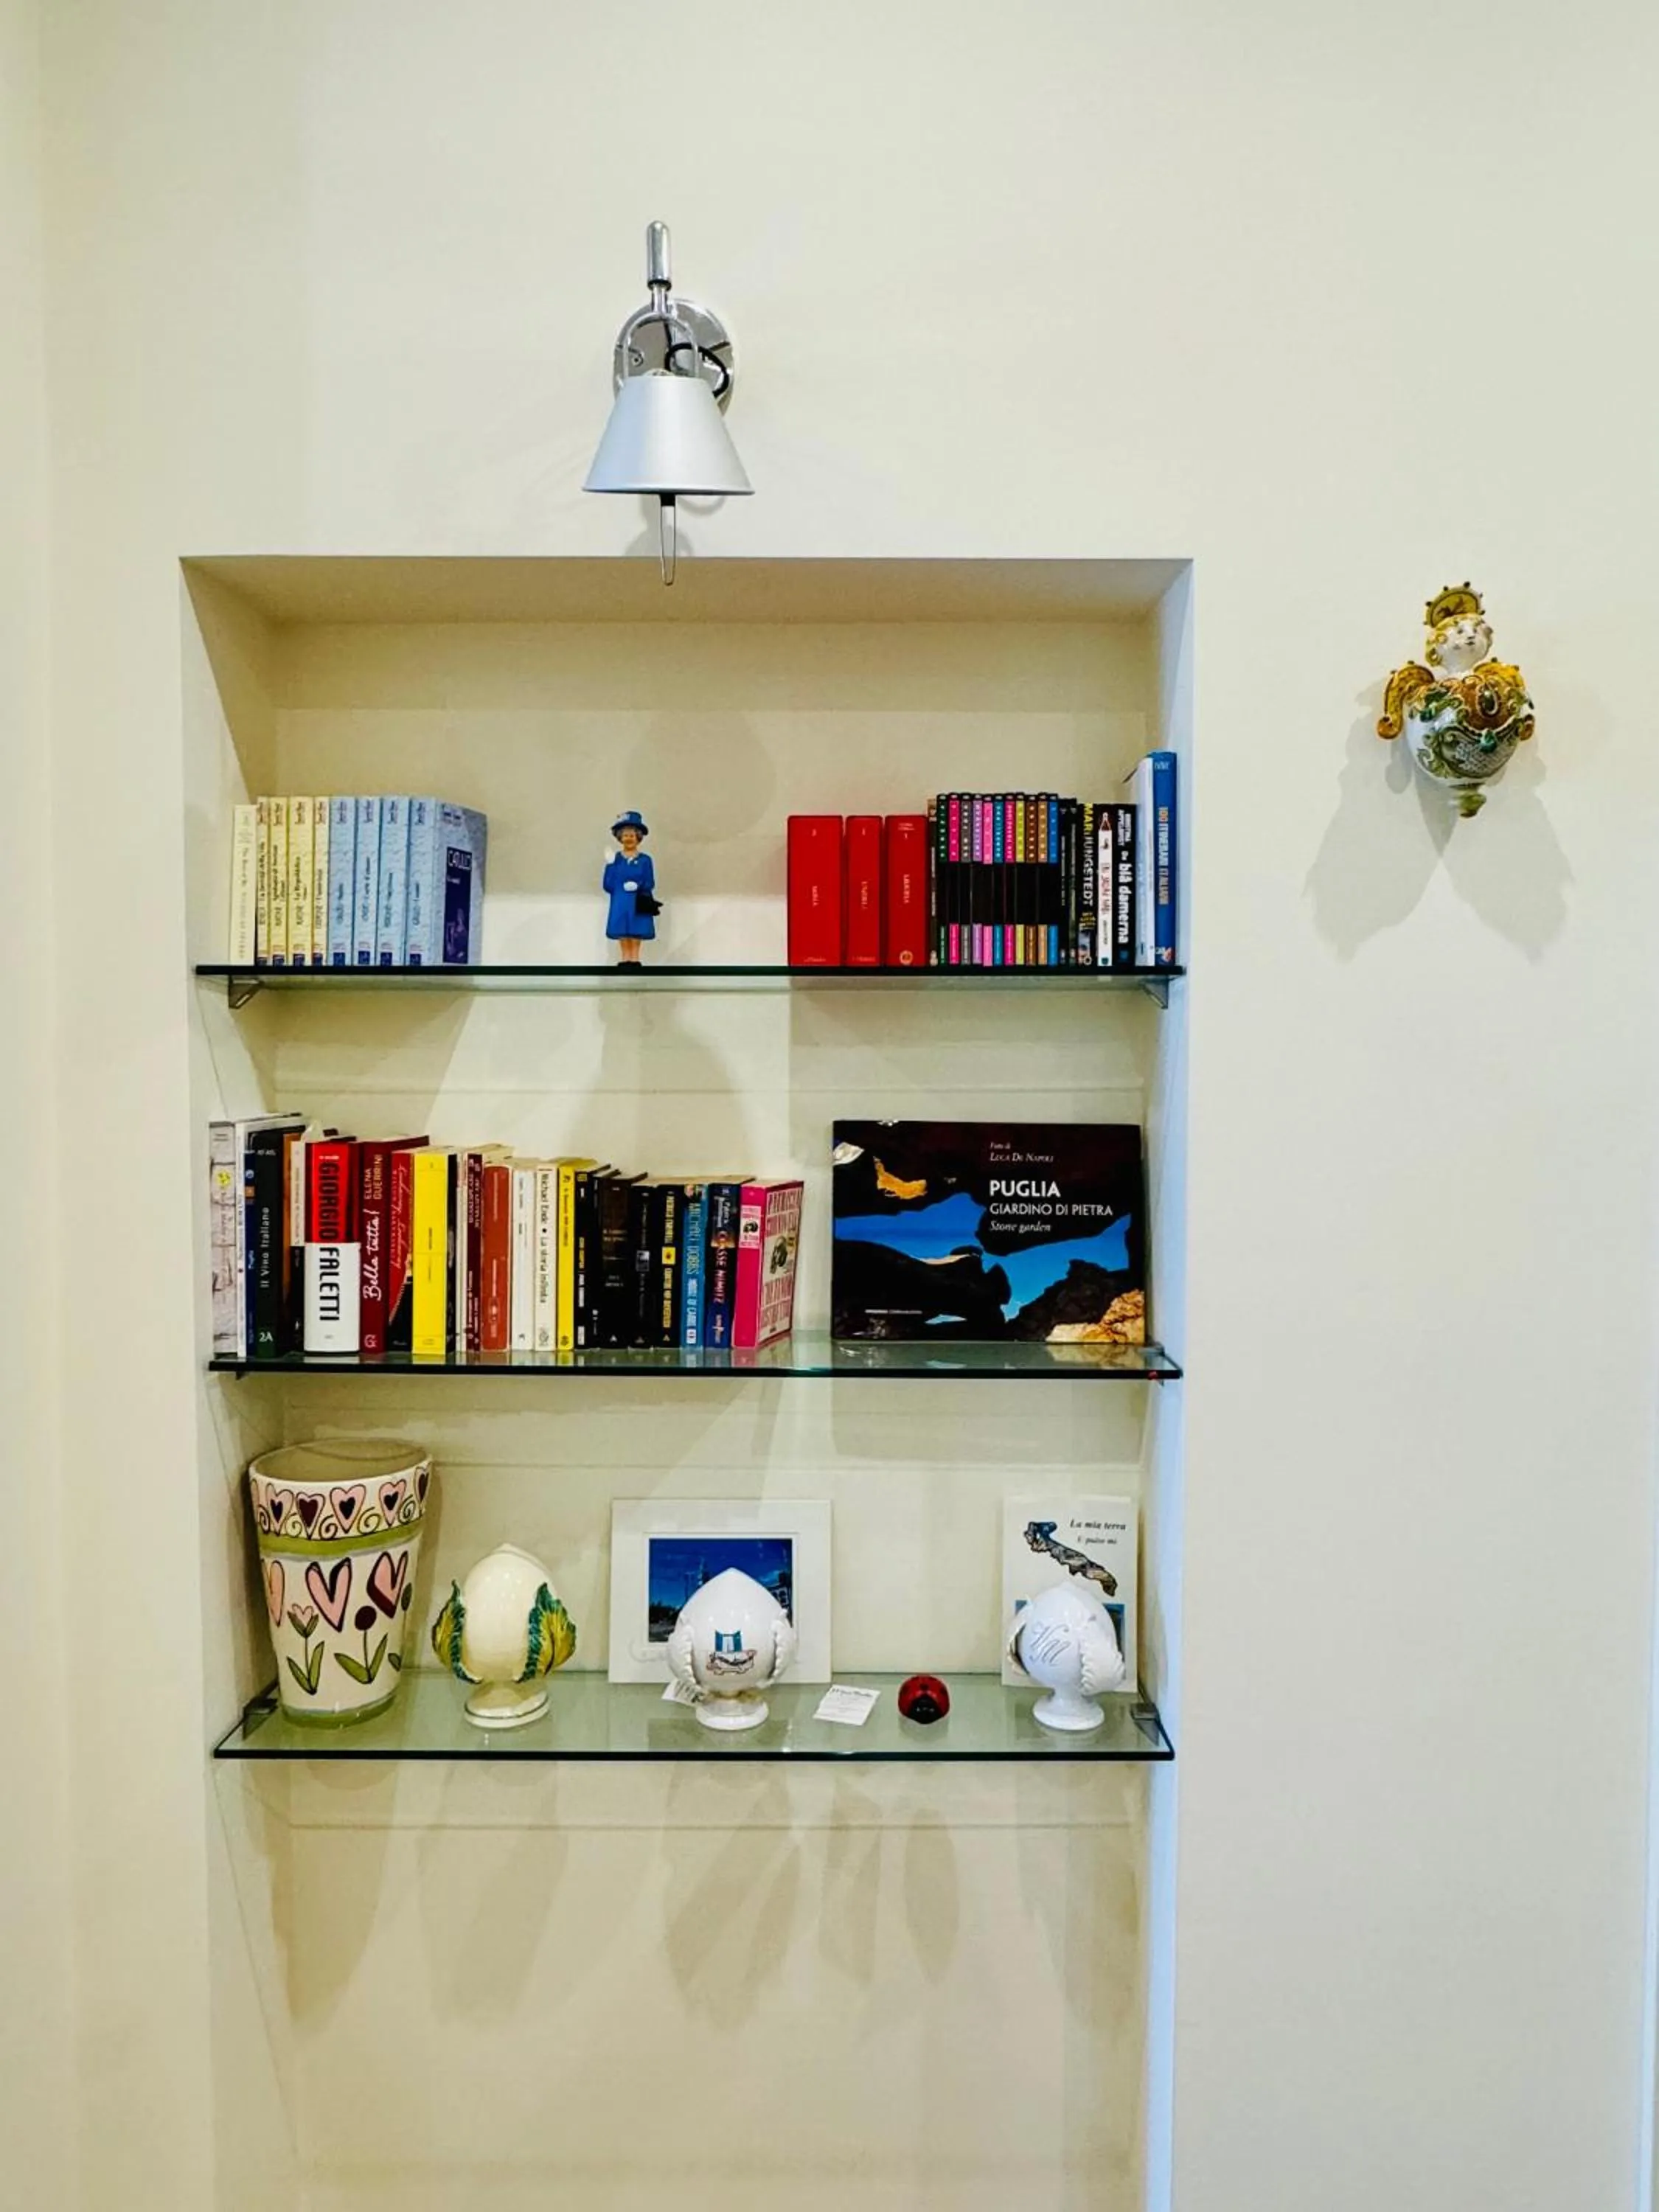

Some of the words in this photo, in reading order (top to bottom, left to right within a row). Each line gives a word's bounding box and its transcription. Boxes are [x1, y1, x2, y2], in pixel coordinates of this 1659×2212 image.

[1083, 834, 1094, 907] JUNGSTEDT
[1117, 863, 1133, 883] blå
[1117, 886, 1132, 944] damerna
[364, 1169, 372, 1200] ELENA
[373, 1154, 383, 1200] GUERRINI
[540, 1174, 549, 1203] Michael
[989, 1180, 1062, 1197] PUGLIA
[318, 1161, 341, 1240] GIORGIO
[540, 1204, 549, 1225] Ende
[989, 1203, 1053, 1216] GIARDINO
[1055, 1204, 1068, 1216] DI
[1071, 1204, 1113, 1217] PIETRA
[260, 1207, 271, 1248] Italiano
[688, 1203, 701, 1242] MICHAEL
[990, 1220, 1018, 1231] Stone
[1018, 1220, 1052, 1234] garden
[260, 1252, 271, 1276] Vino
[686, 1245, 700, 1275] DOBBS
[319, 1247, 340, 1322] FALETTI
[363, 1255, 382, 1301] Bella
[713, 1269, 726, 1303] NIMITZ
[259, 1332, 274, 1343] 2A
[1070, 1518, 1082, 1528] La
[1085, 1520, 1102, 1529] mia
[1103, 1521, 1127, 1531] terra
